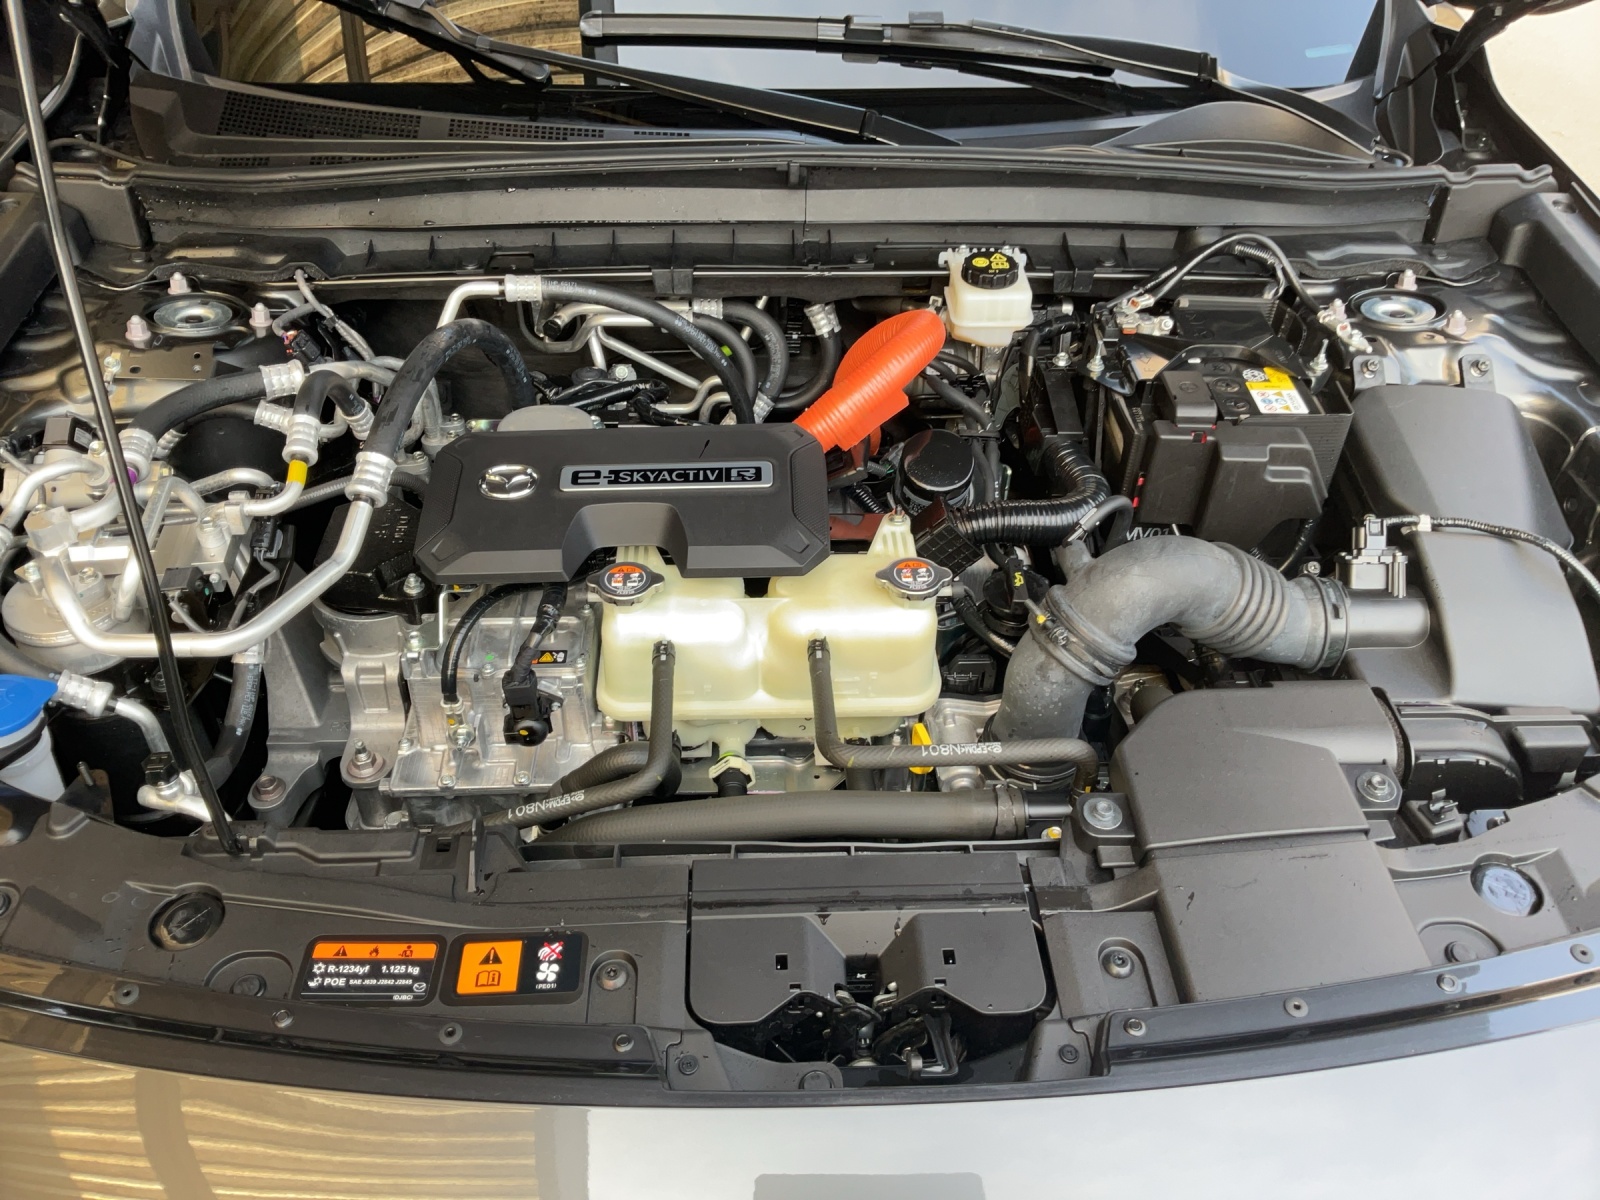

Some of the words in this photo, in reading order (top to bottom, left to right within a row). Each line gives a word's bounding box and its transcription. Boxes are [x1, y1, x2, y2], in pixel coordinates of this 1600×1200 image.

[921, 743, 960, 757] N801
[507, 800, 546, 819] N801
[327, 964, 370, 975] R-1234yf
[381, 965, 406, 973] 1.125
[407, 965, 420, 975] kg
[323, 978, 347, 986] POE
